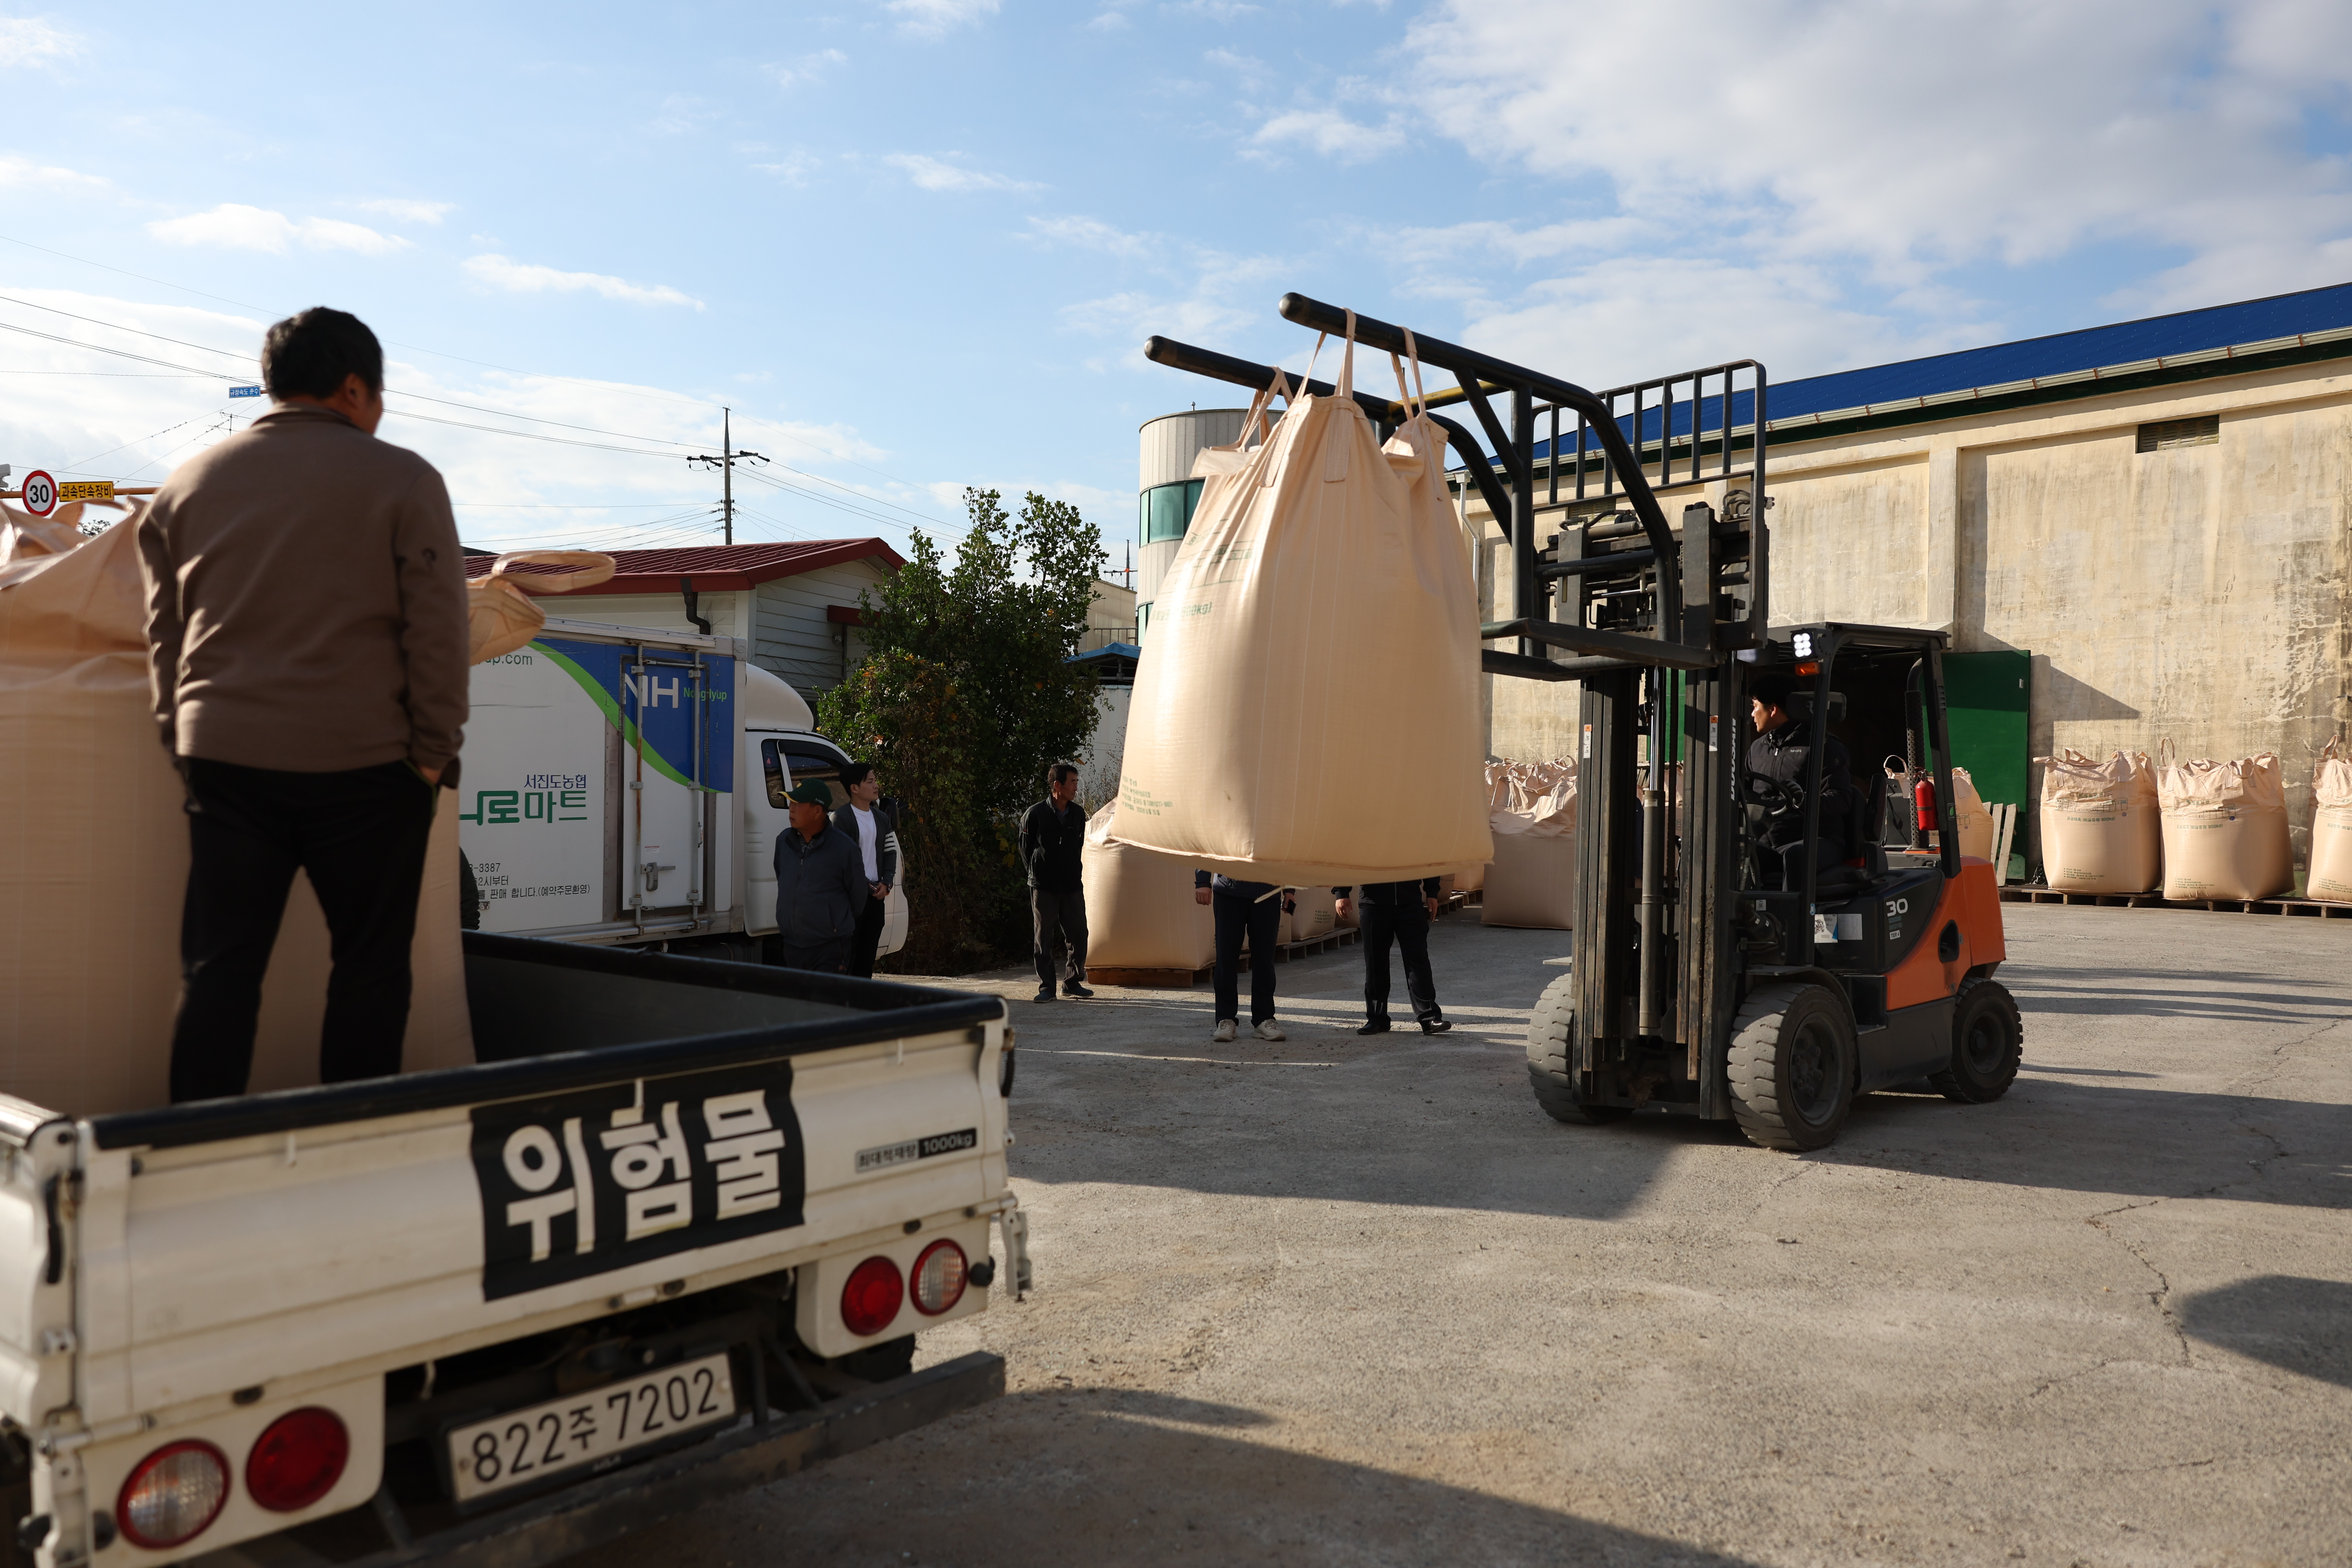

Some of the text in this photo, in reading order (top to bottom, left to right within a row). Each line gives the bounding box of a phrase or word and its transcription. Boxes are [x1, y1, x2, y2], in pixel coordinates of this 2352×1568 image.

[30, 485, 49, 503] 30
[62, 484, 111, 499] 과속단속장비
[624, 673, 679, 708] NH
[684, 687, 727, 702] Nogyup
[524, 774, 586, 789] 서진도농협
[490, 889, 506, 899] 판매
[1886, 898, 1908, 917] 30
[923, 1134, 973, 1154] 1000kg
[503, 1089, 785, 1263] 위험물
[608, 1367, 718, 1441] 7202
